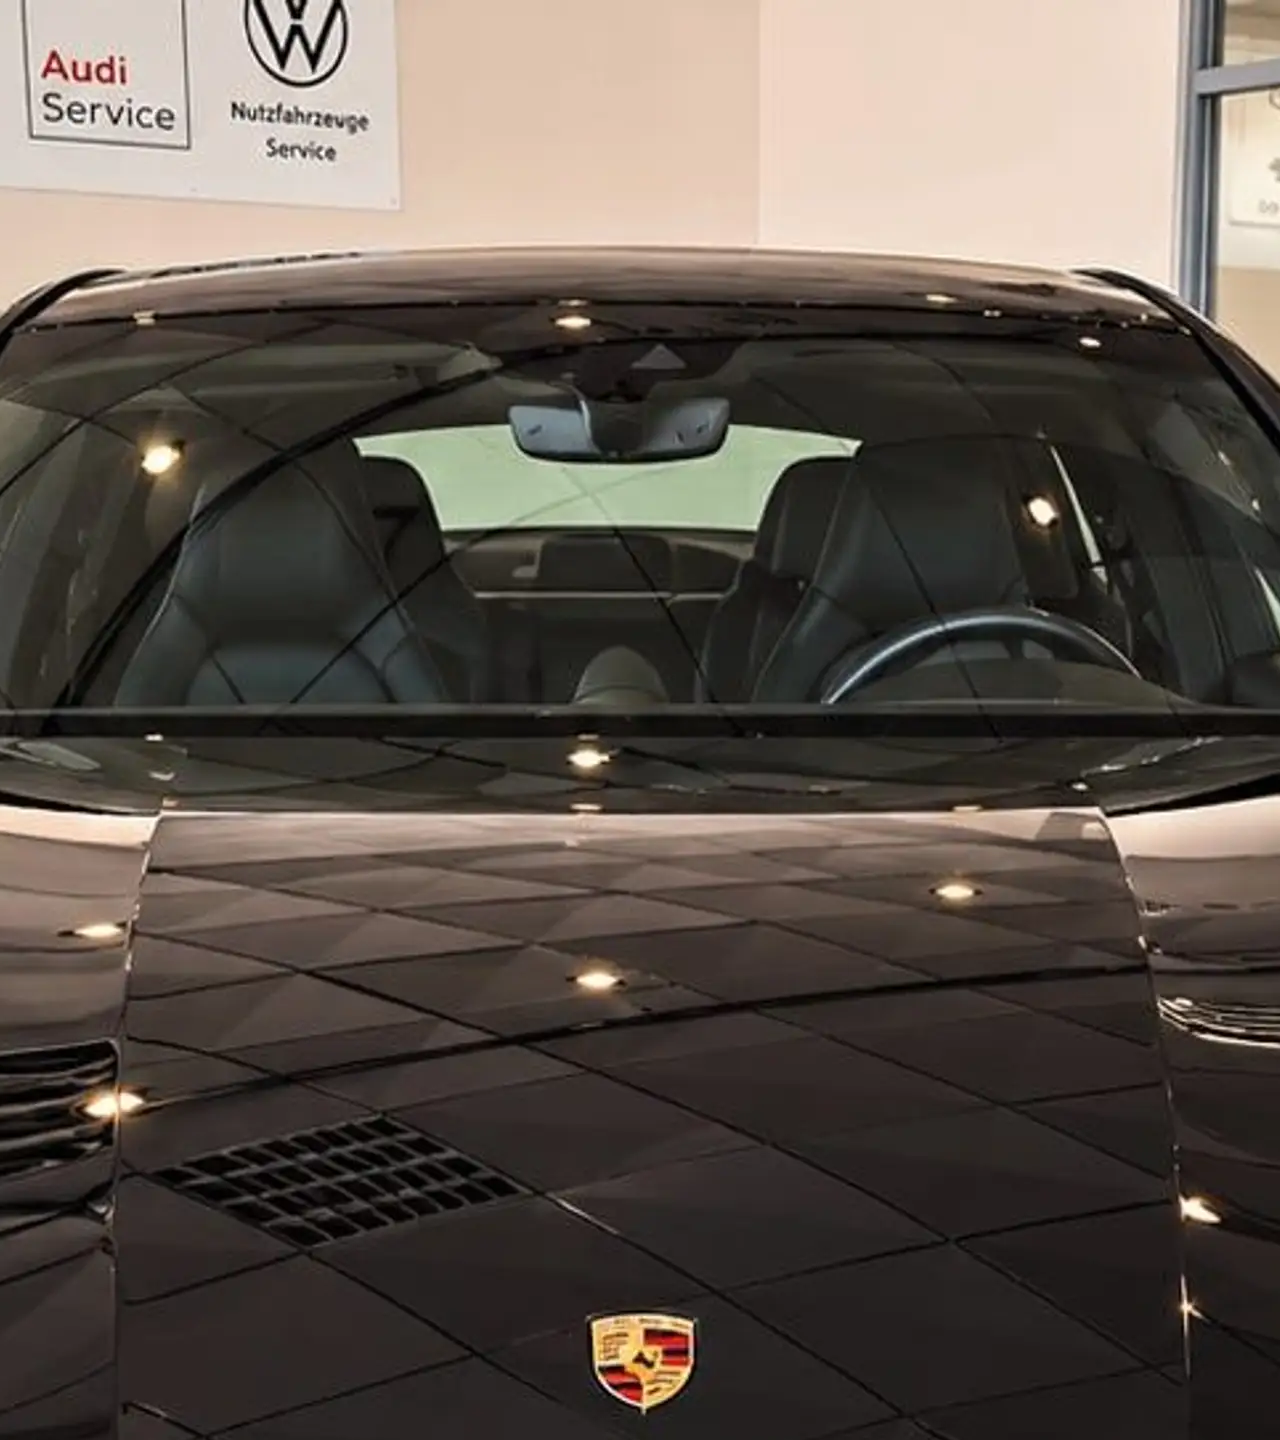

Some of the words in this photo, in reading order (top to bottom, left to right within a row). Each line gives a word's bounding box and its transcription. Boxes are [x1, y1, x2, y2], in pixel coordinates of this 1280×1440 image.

[40, 50, 127, 85] Audi
[42, 92, 176, 131] Service
[231, 101, 370, 135] Nutzfahrzeuge
[265, 137, 338, 162] Service
